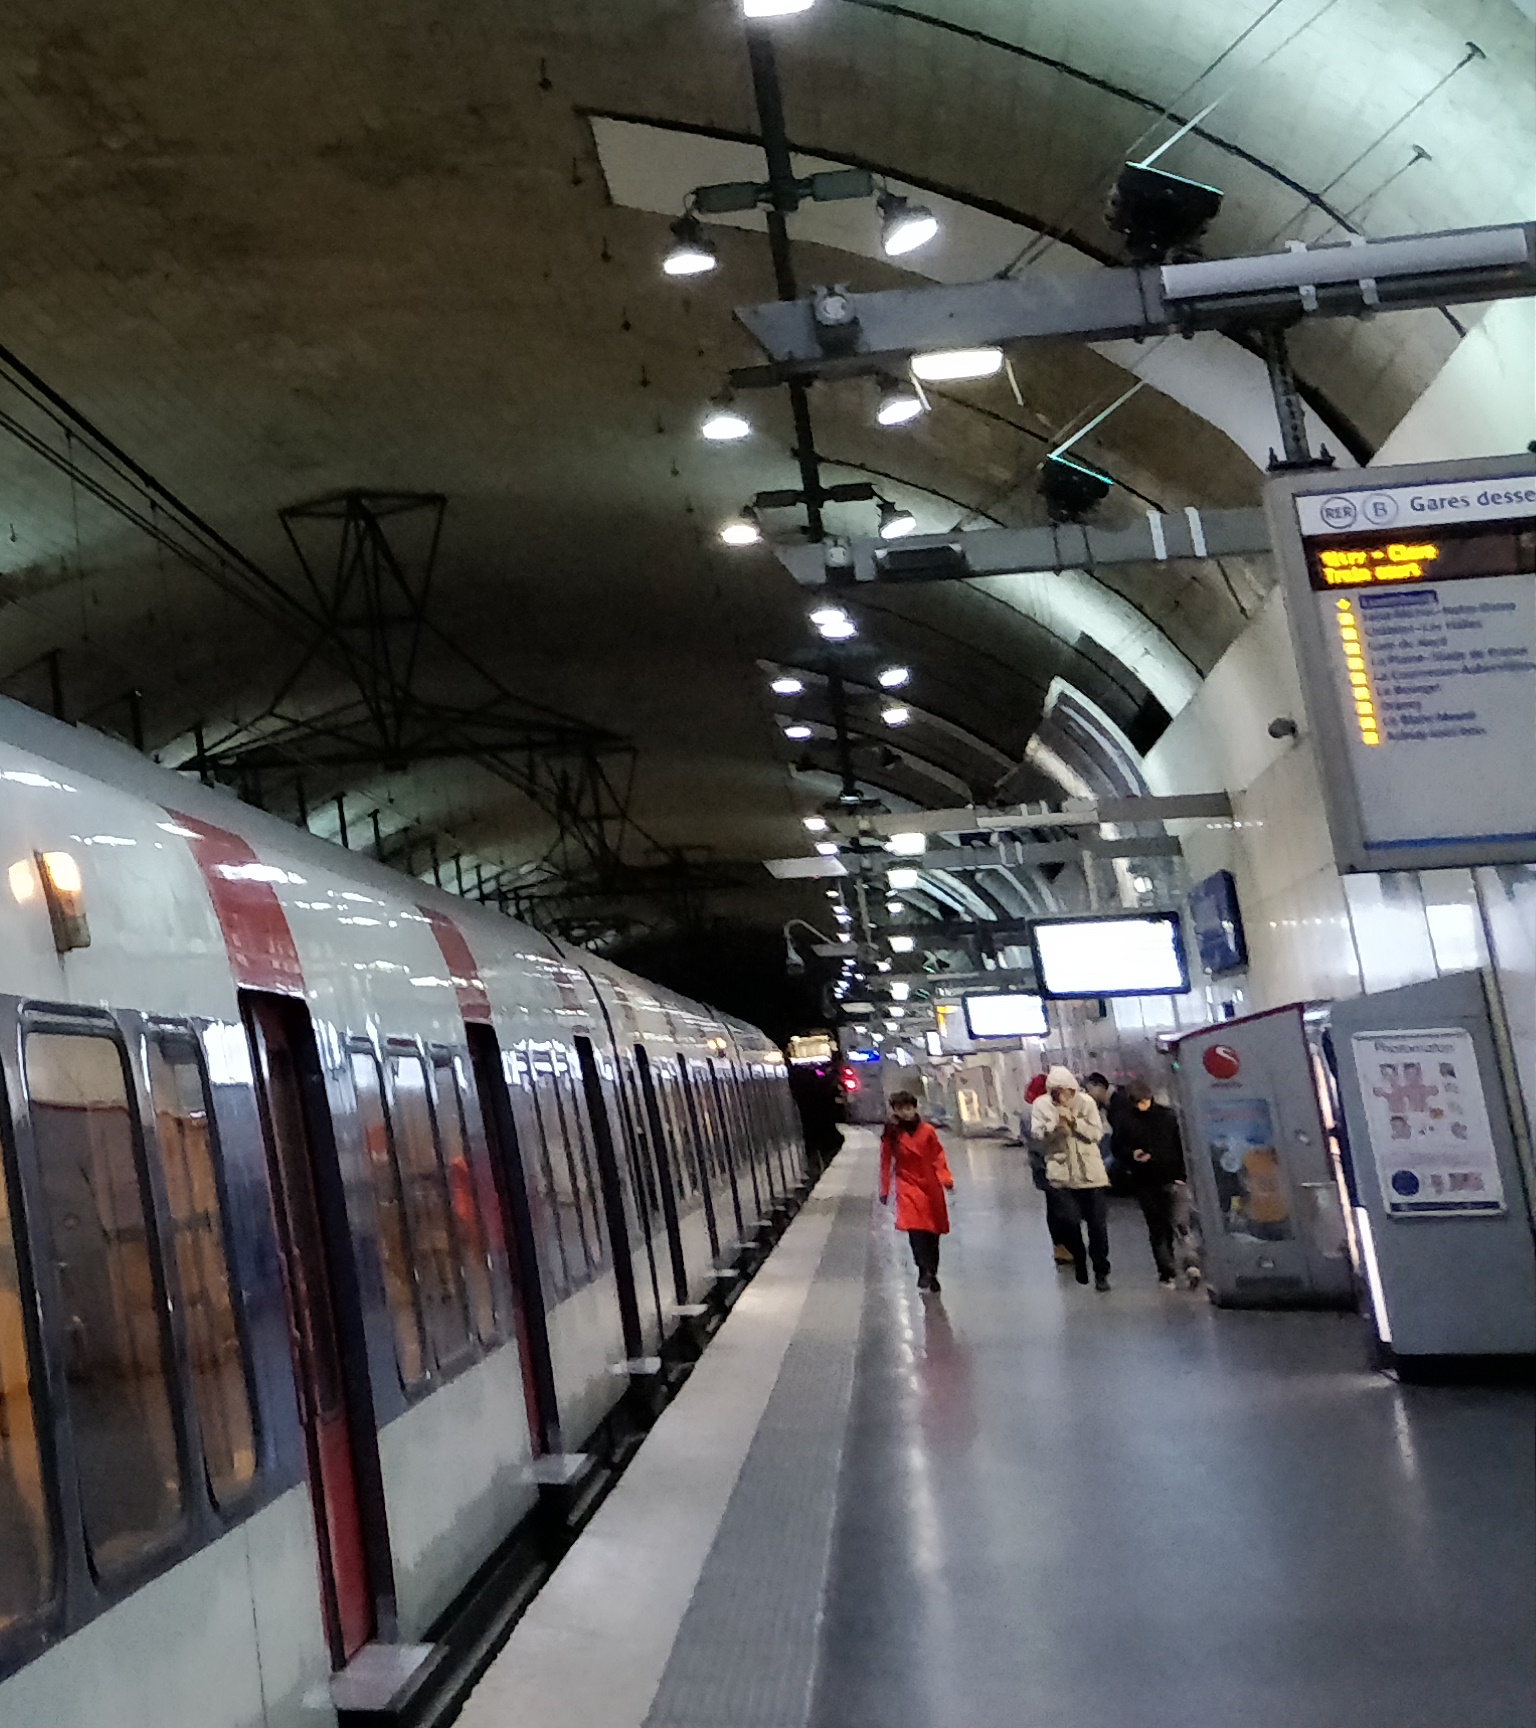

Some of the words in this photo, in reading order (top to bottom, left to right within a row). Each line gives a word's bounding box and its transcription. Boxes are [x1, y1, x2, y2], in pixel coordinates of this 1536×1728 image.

[1324, 506, 1353, 520] RER
[1373, 501, 1388, 517] B
[1410, 495, 1470, 513] Gares
